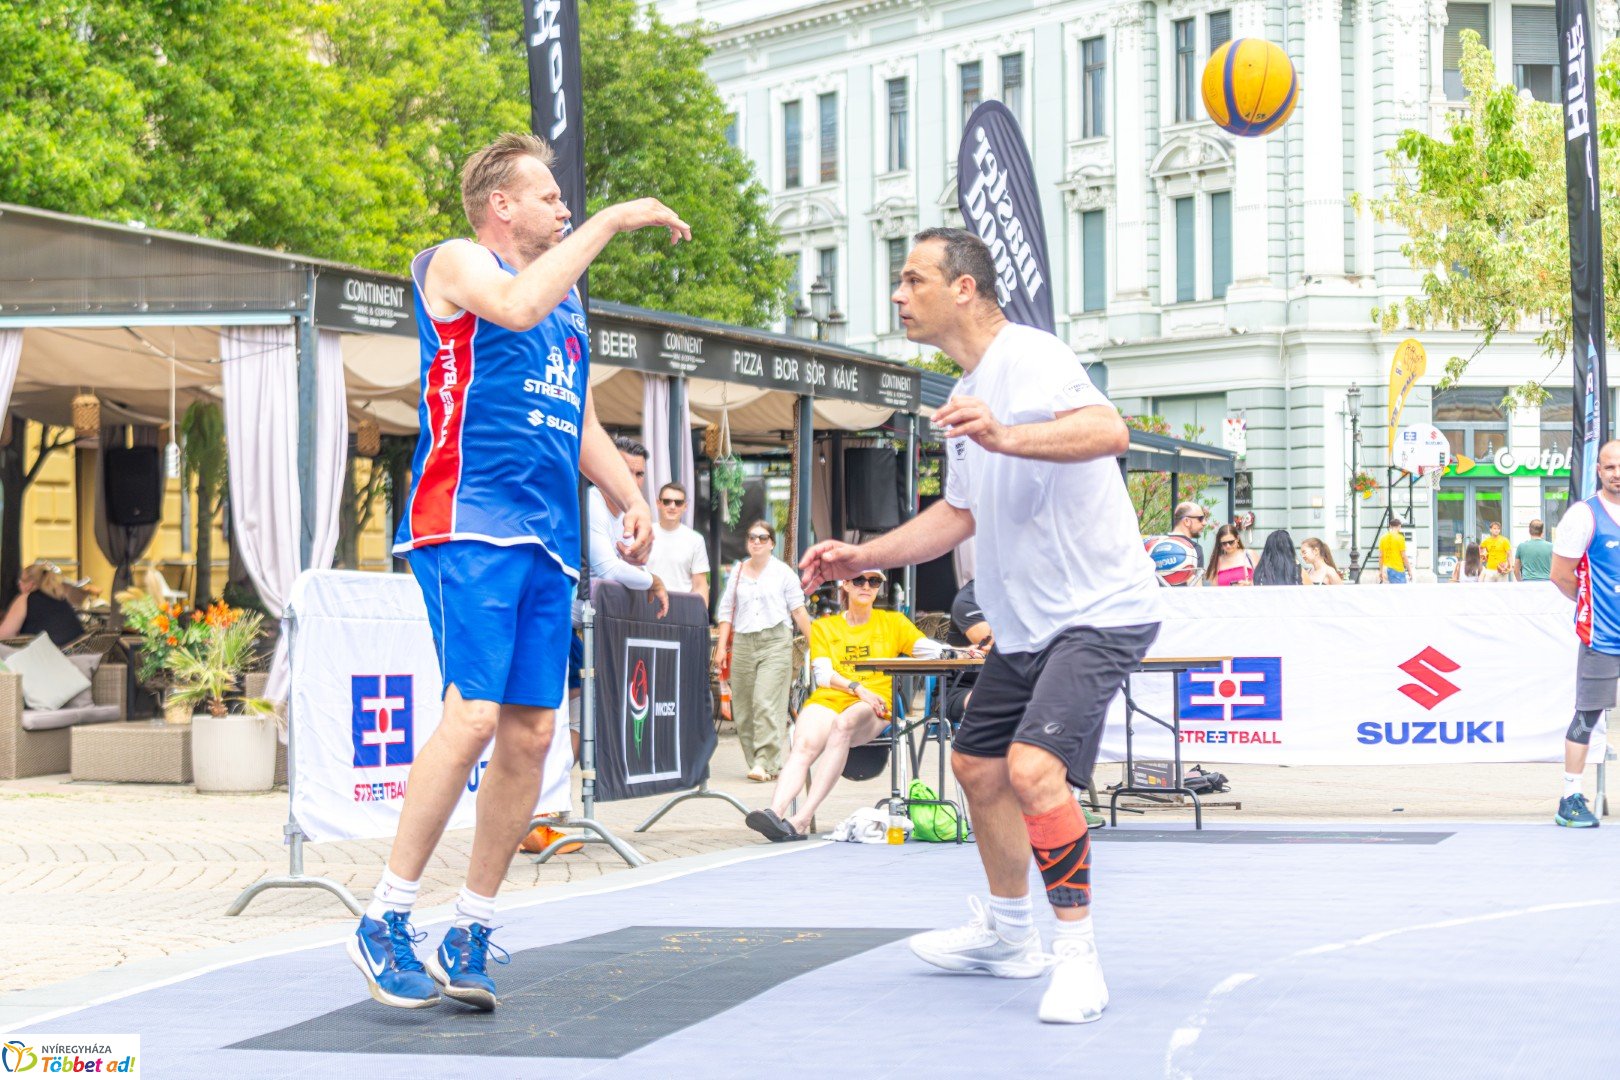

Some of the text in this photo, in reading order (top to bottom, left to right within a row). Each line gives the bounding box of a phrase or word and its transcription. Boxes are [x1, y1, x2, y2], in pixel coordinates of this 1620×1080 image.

[345, 278, 405, 308] CONTINENT
[601, 330, 638, 359] BEER
[665, 332, 703, 355] CONTINENT
[733, 350, 859, 392] PIZZA BOR SÖR KÁVÉ
[881, 373, 911, 392] CONTINENT
[1179, 730, 1282, 744] STREETBALL
[1357, 720, 1505, 745] SUZUKI
